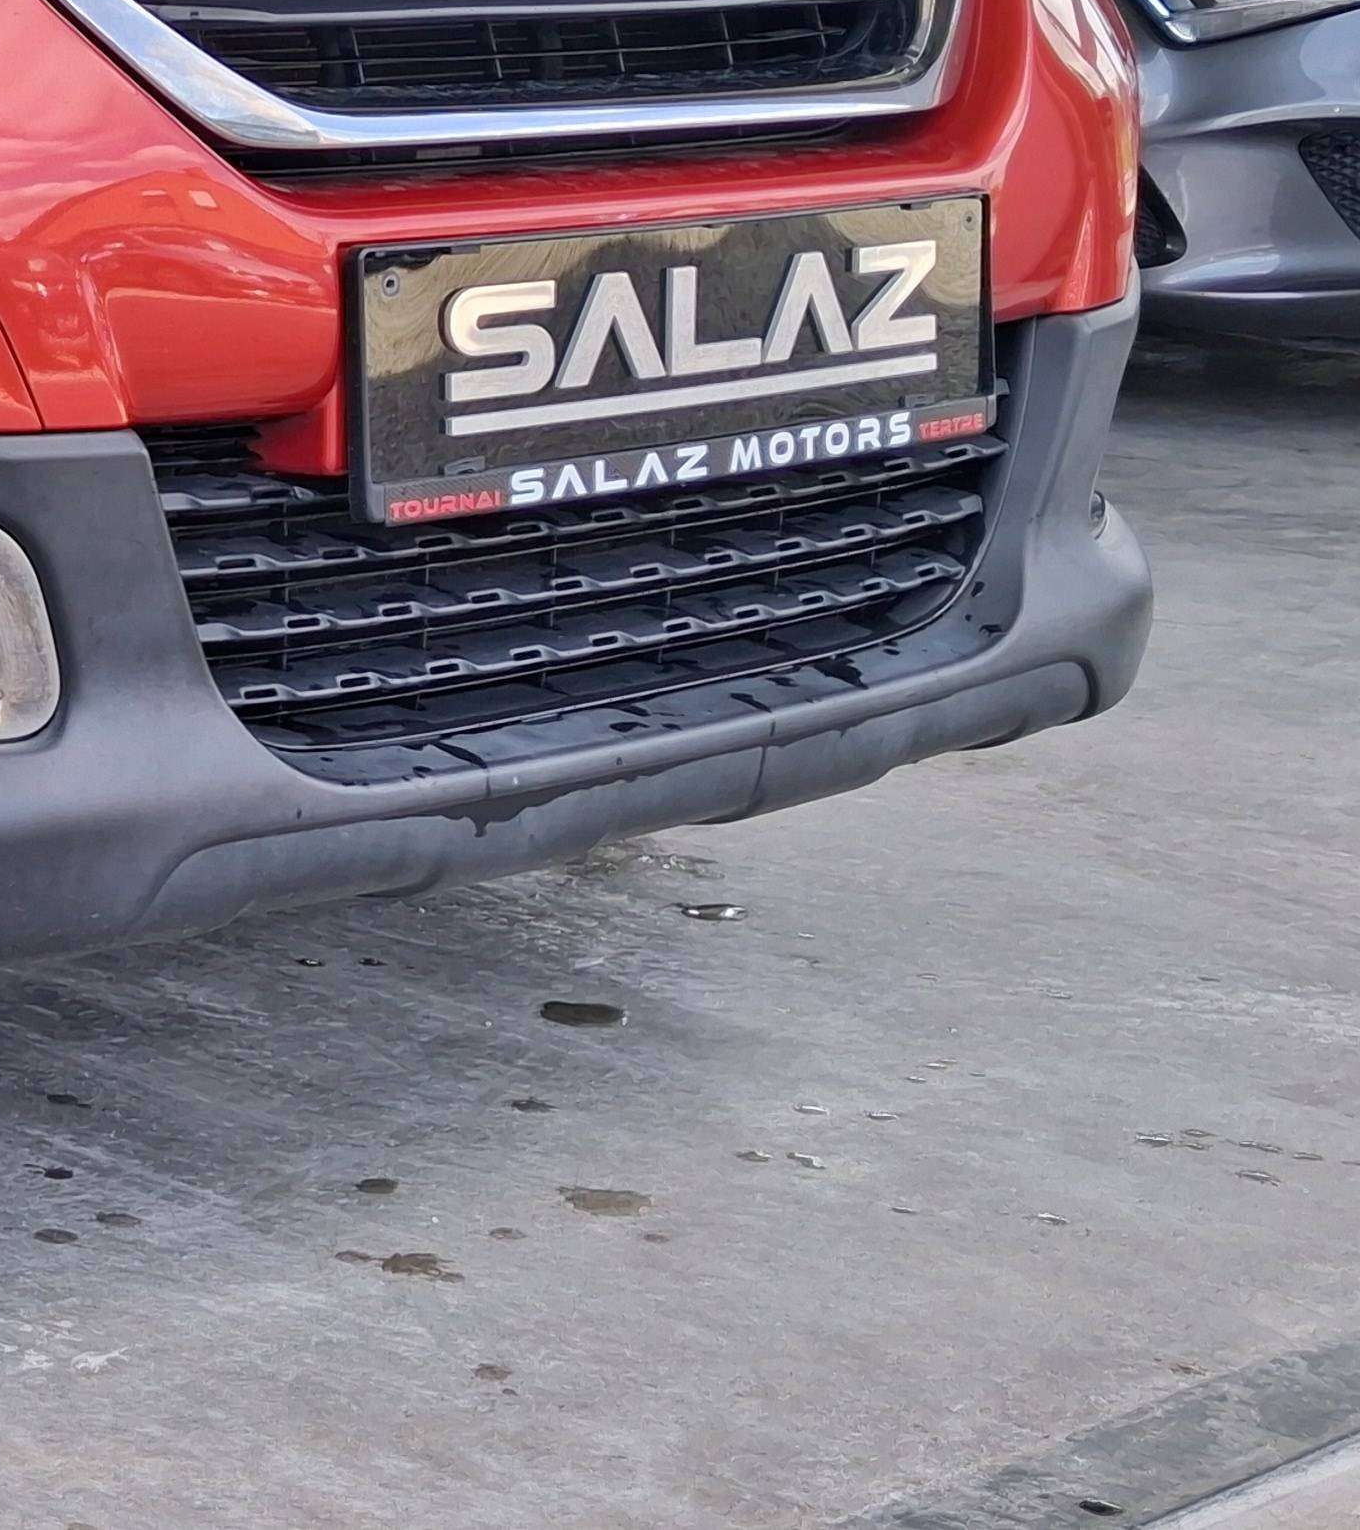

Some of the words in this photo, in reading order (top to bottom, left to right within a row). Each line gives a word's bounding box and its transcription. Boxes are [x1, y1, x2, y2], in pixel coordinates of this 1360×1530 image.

[443, 239, 937, 402] SALAZ
[389, 490, 502, 522] TOURNAI
[510, 444, 709, 505] SALAZ
[730, 412, 912, 472] MOTORS
